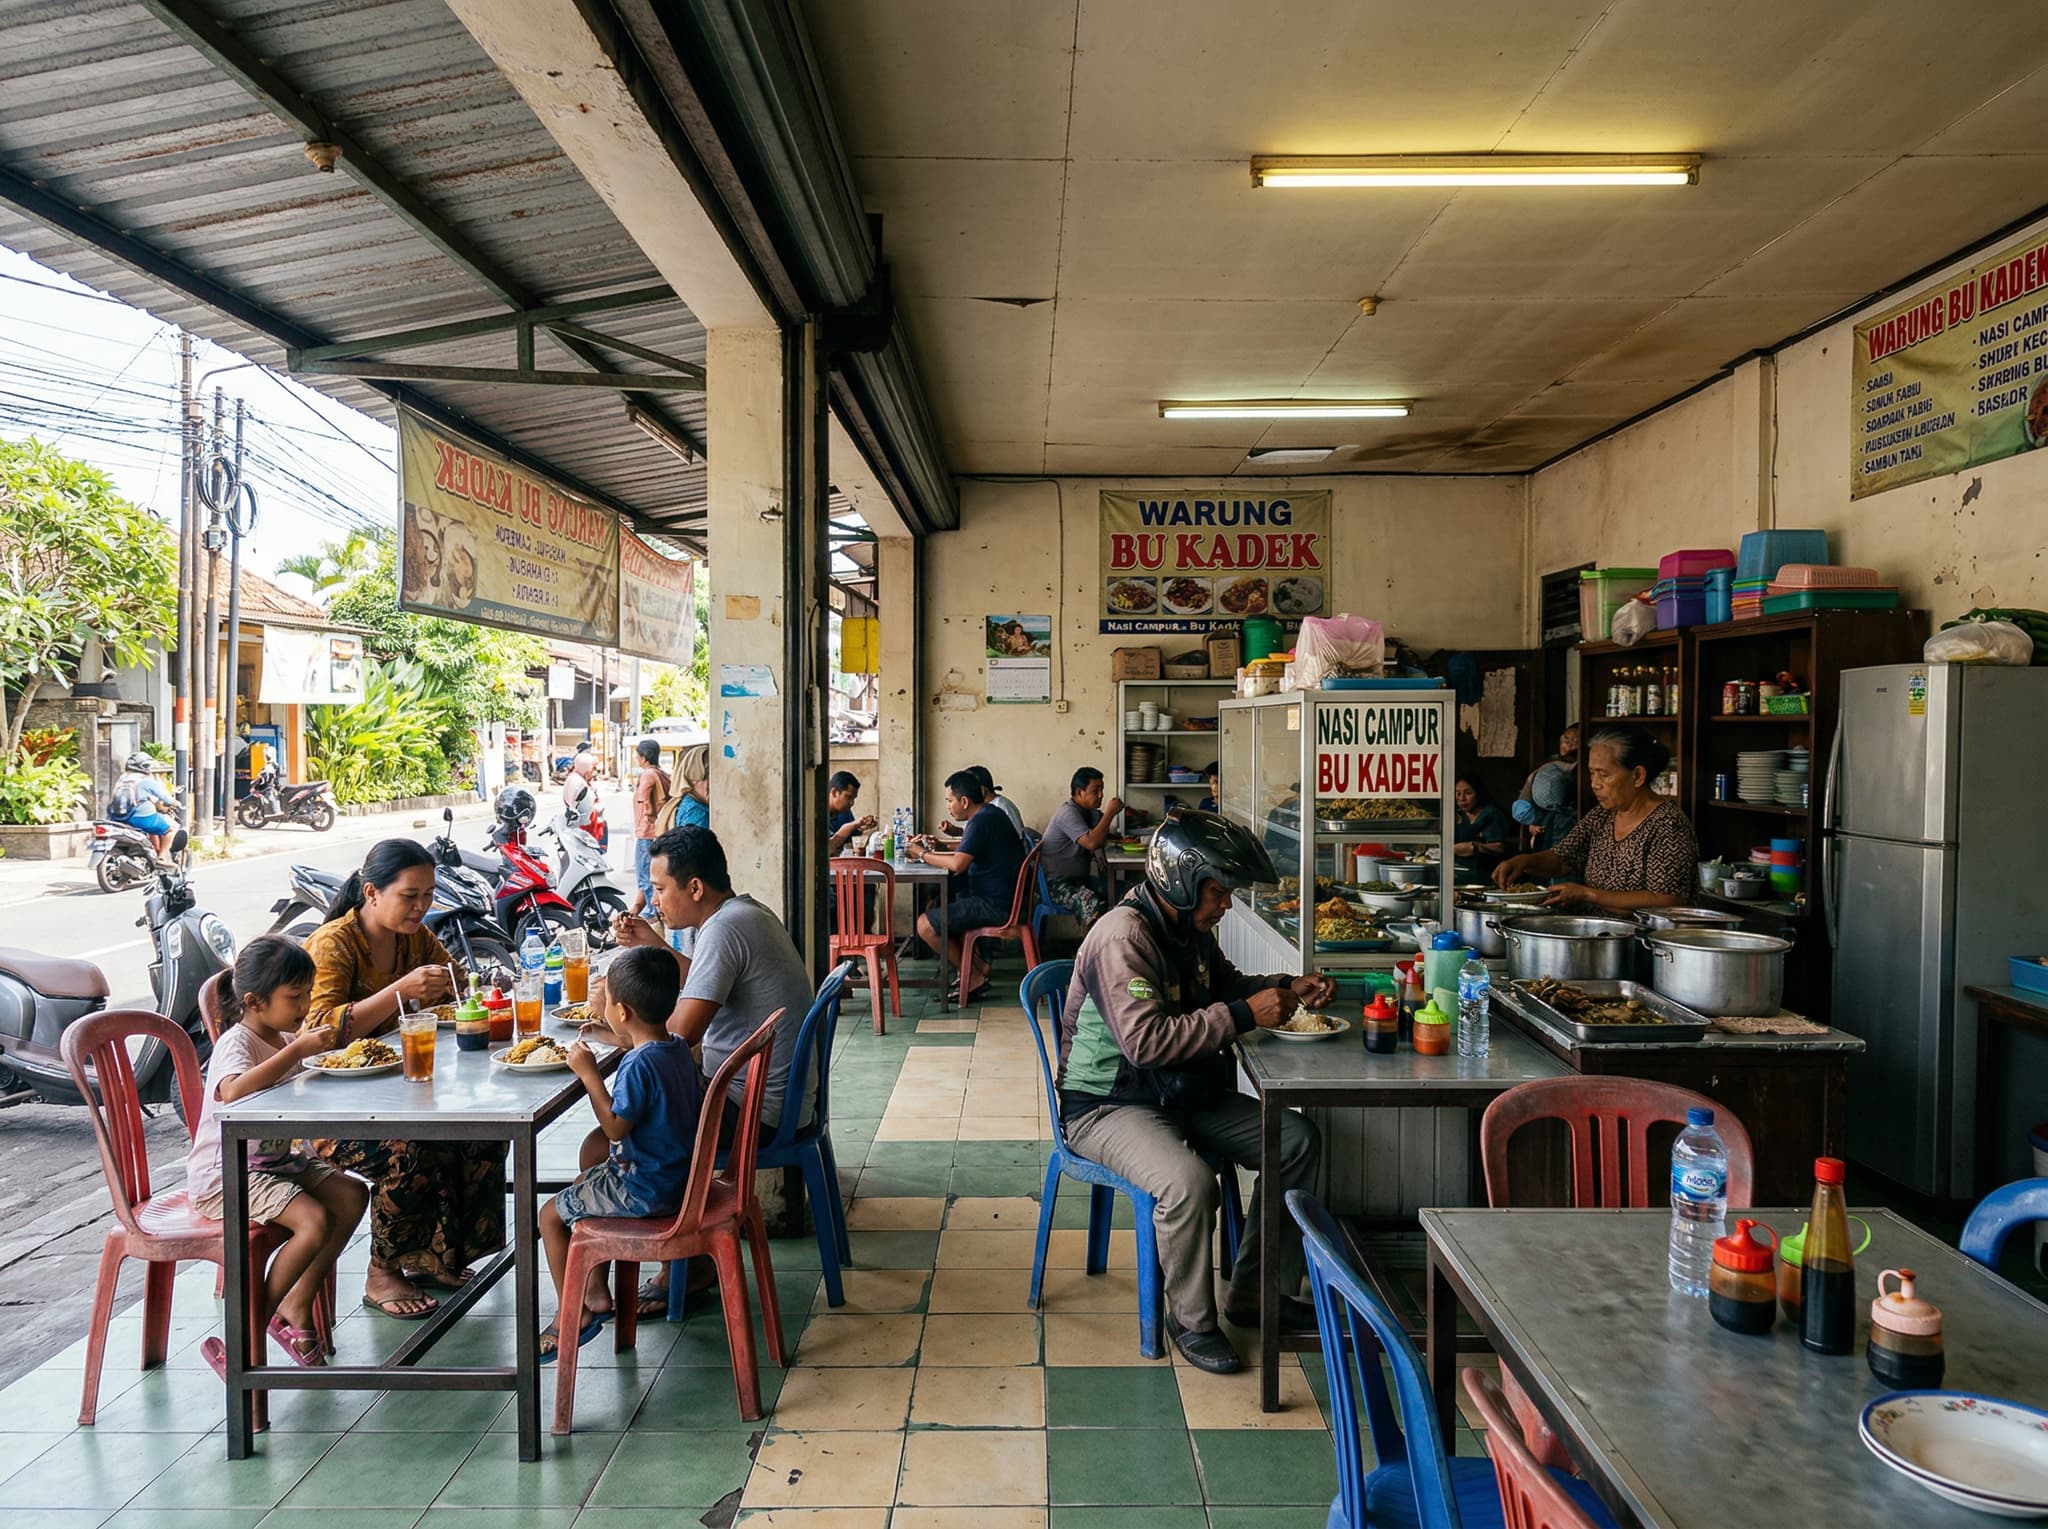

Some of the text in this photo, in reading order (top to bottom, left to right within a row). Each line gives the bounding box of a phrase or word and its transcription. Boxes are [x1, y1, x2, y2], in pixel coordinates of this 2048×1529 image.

[1868, 244, 2048, 361] WARUNG BU KADEK
[1980, 321, 2009, 346] NASI
[1138, 500, 1292, 527] WARUNG
[1110, 532, 1321, 570] BU KADEK
[1318, 708, 1440, 745] NASI CAMPUR
[1318, 752, 1440, 793] BU KADEK
